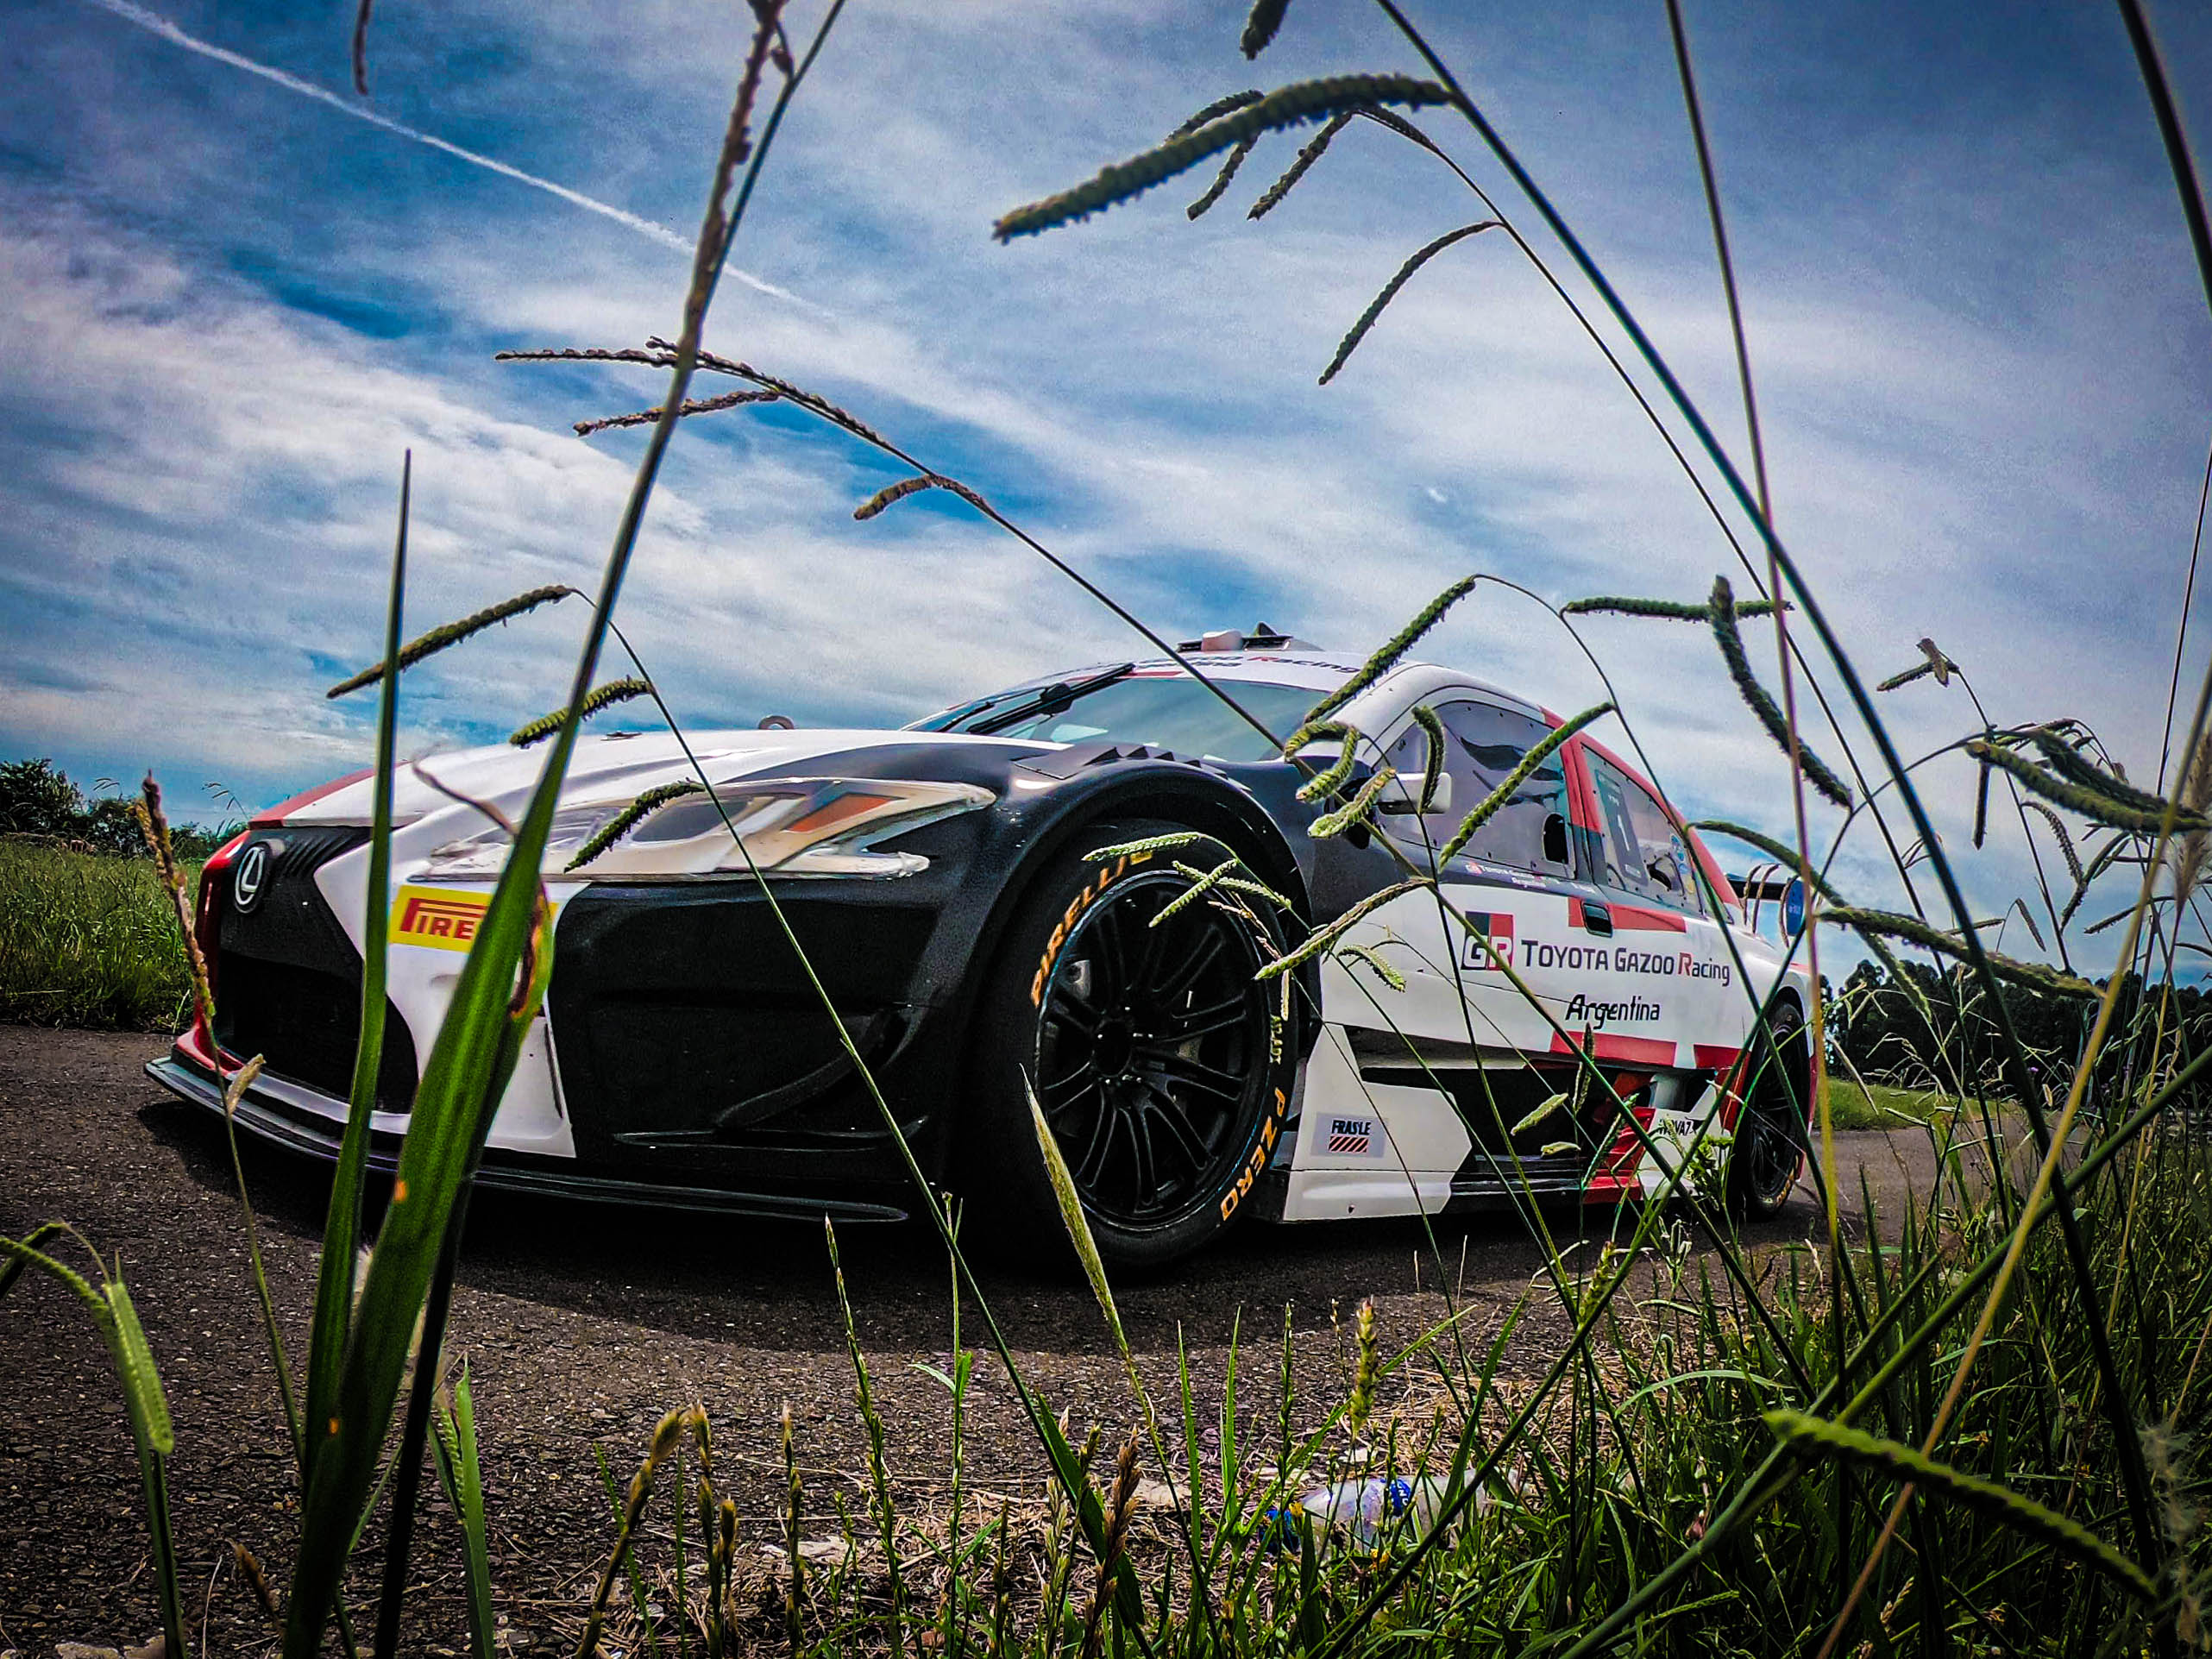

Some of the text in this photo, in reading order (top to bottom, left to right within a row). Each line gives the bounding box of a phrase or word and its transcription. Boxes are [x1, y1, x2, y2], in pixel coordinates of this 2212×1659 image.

[1521, 939, 1609, 971] TOYOTA
[1615, 947, 1675, 975] GAZOO
[1678, 952, 1731, 986] Racing
[1565, 994, 1661, 1029] Argentina
